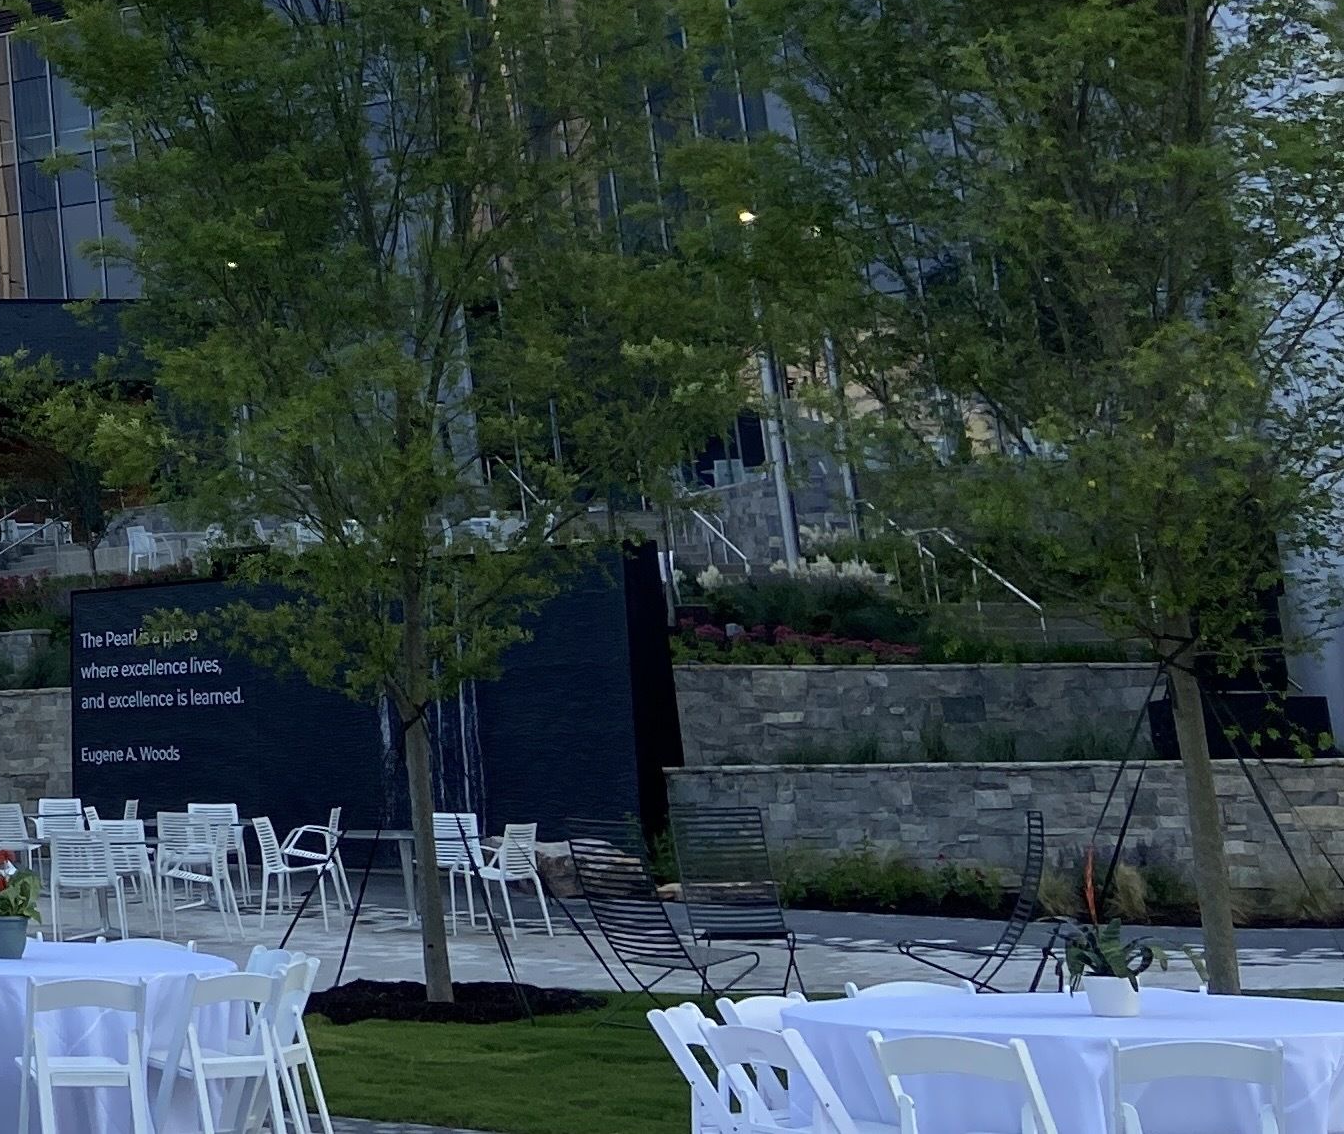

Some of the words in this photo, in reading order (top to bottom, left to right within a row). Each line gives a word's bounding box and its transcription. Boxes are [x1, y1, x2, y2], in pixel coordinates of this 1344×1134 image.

[80, 632, 103, 648] The
[106, 629, 136, 647] Pearl
[80, 662, 119, 679] where
[121, 659, 188, 677] excellence
[190, 656, 222, 675] lives,
[81, 692, 105, 709] and
[108, 690, 174, 708] excellence
[176, 688, 188, 706] is
[190, 686, 245, 705] learned.
[81, 747, 124, 765] Eugene
[126, 747, 138, 762] A.
[139, 745, 181, 762] Woods
